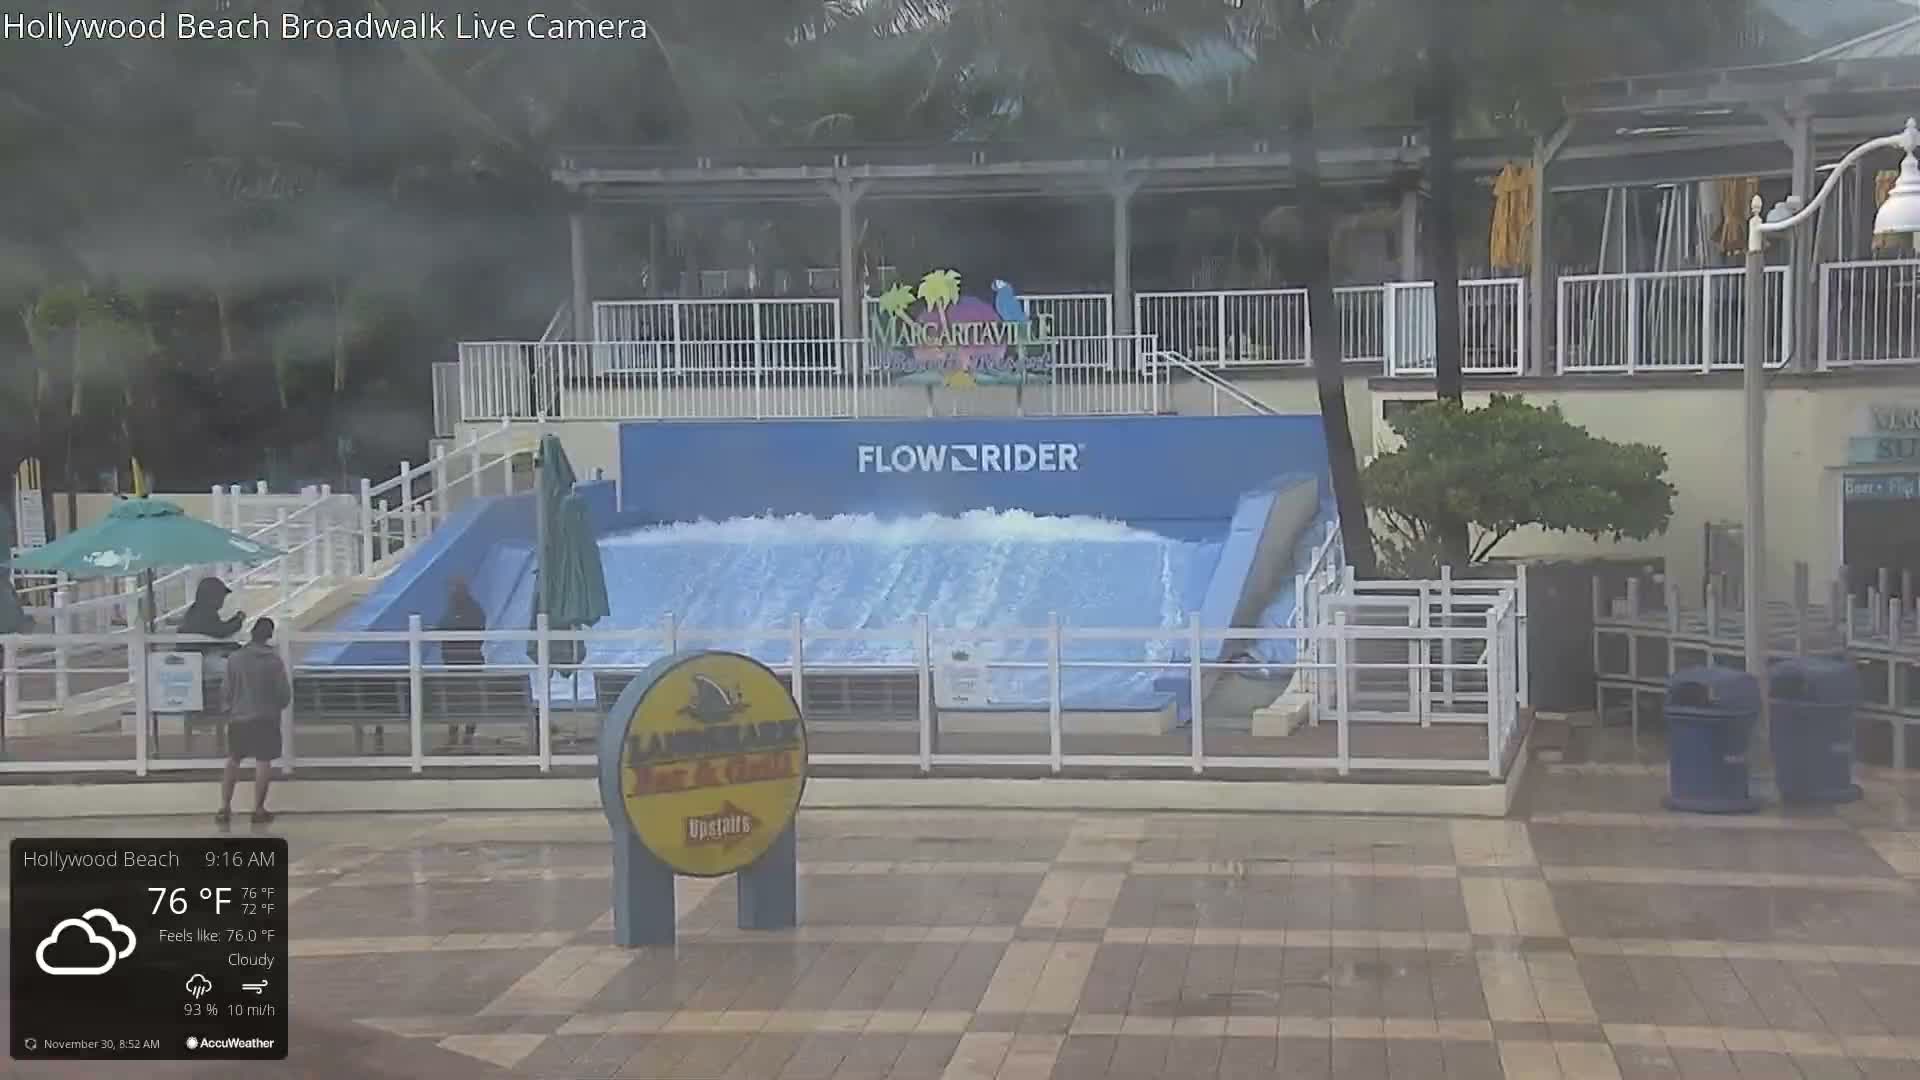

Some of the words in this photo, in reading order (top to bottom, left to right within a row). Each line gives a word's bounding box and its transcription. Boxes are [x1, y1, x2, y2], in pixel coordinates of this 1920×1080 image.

[857, 445, 948, 473] FLOW
[981, 443, 1079, 472] RIDER
[688, 813, 752, 840] Upstairs
